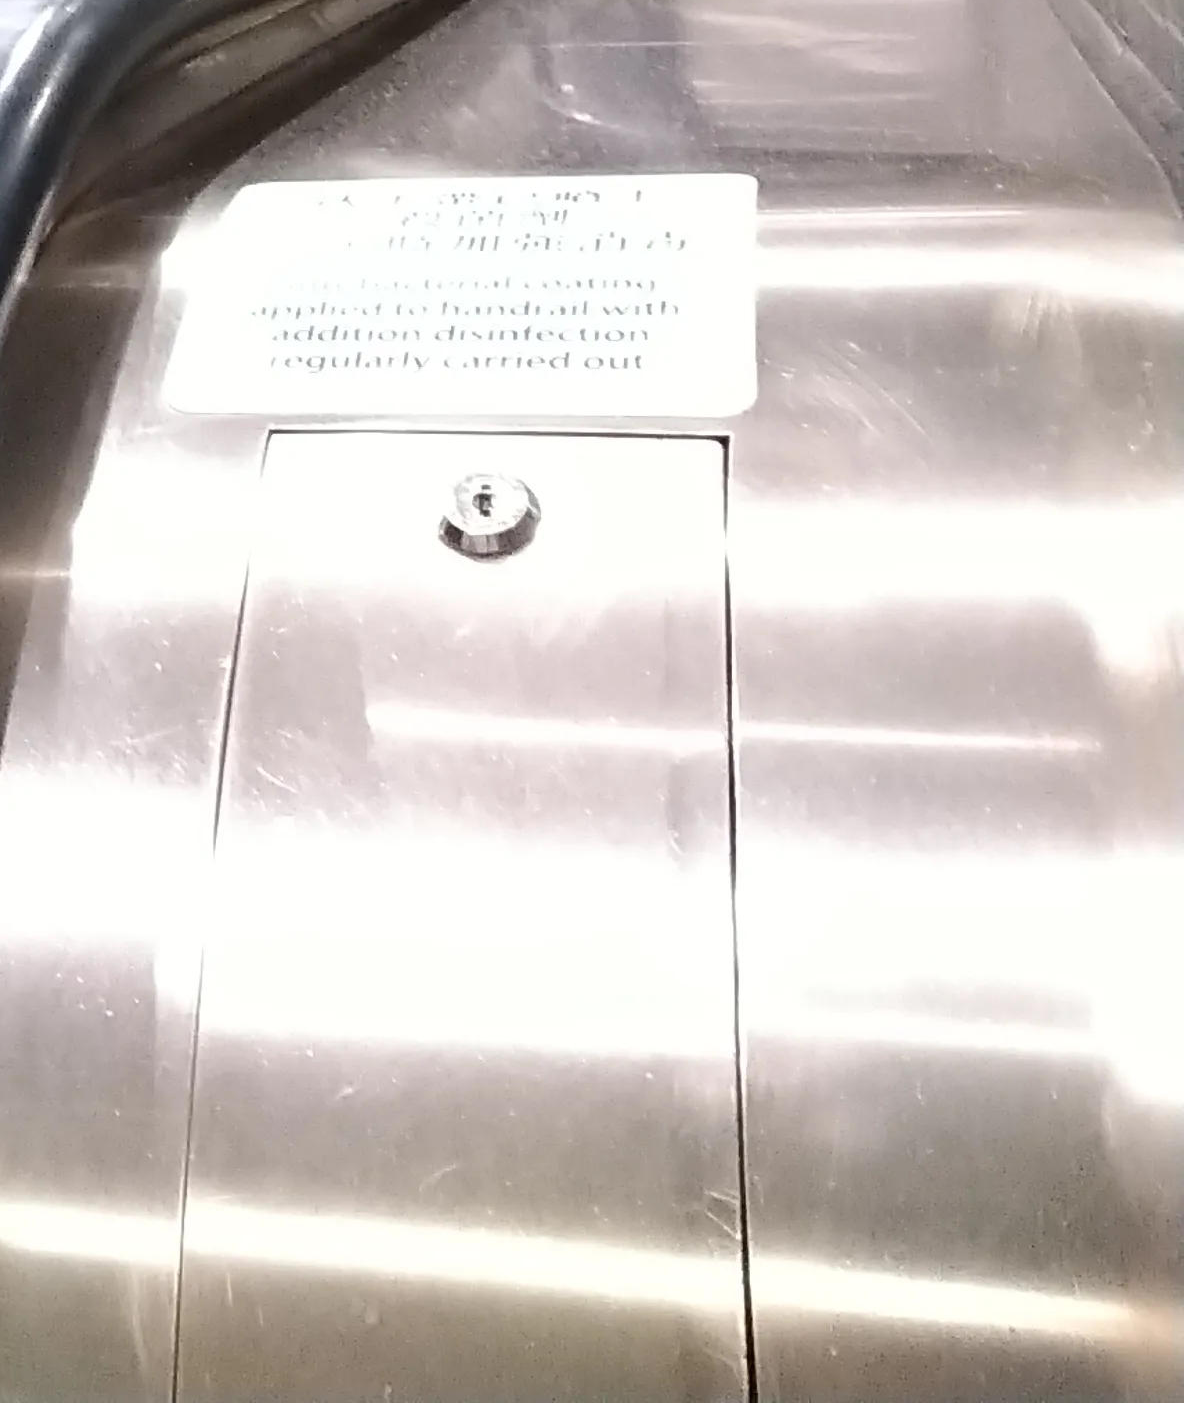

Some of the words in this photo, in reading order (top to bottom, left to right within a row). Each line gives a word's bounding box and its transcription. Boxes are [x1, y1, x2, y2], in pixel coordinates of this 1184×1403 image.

[250, 301, 383, 320] applied
[395, 301, 428, 317] to
[441, 299, 589, 317] handrail
[601, 299, 679, 317] with
[271, 324, 422, 343] addition
[433, 324, 650, 343] disinfection
[269, 351, 431, 374] regularly
[443, 351, 571, 370] carried
[583, 352, 644, 370] out
